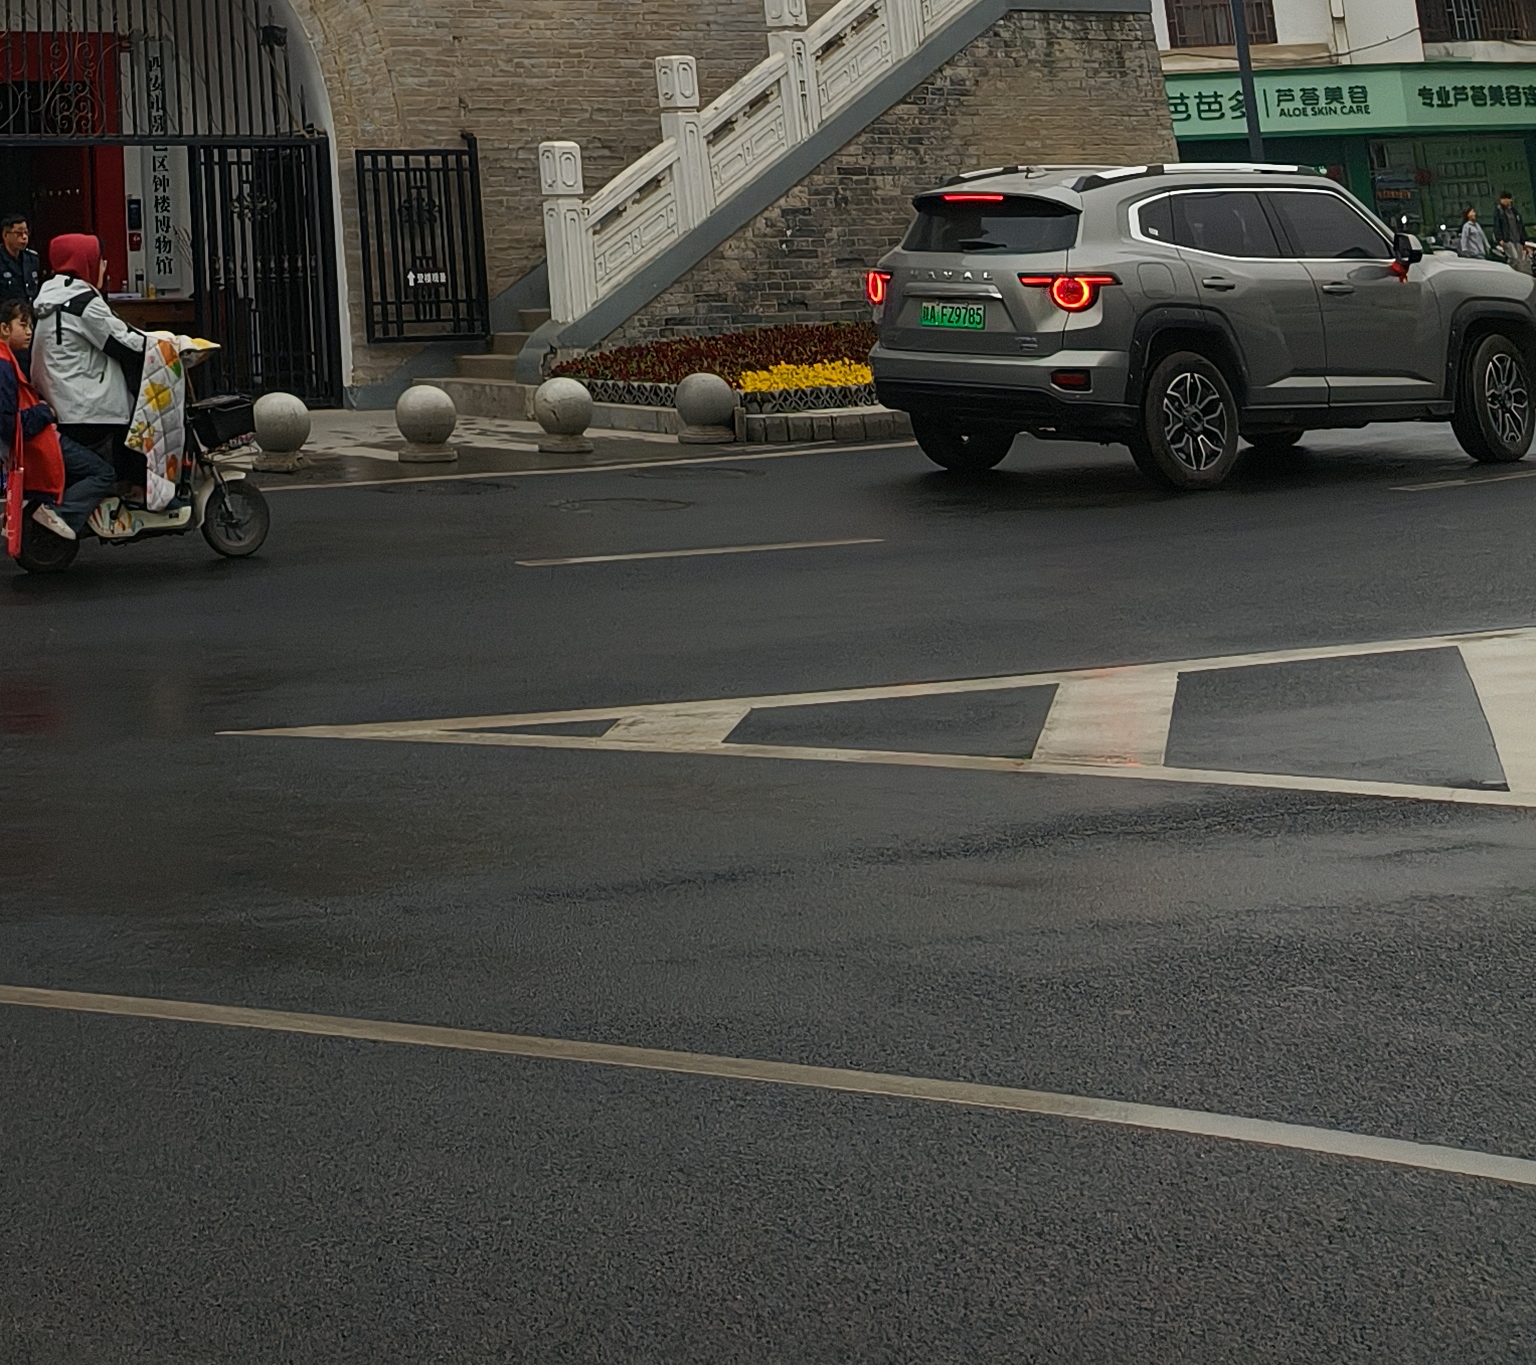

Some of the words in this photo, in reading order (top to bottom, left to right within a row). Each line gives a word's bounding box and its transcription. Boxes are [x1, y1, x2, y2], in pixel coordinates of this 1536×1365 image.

[1275, 85, 1368, 107] 芦荟美容
[1279, 107, 1309, 118] ALOE
[1311, 106, 1338, 117] SKIN
[1340, 104, 1371, 116] CARE
